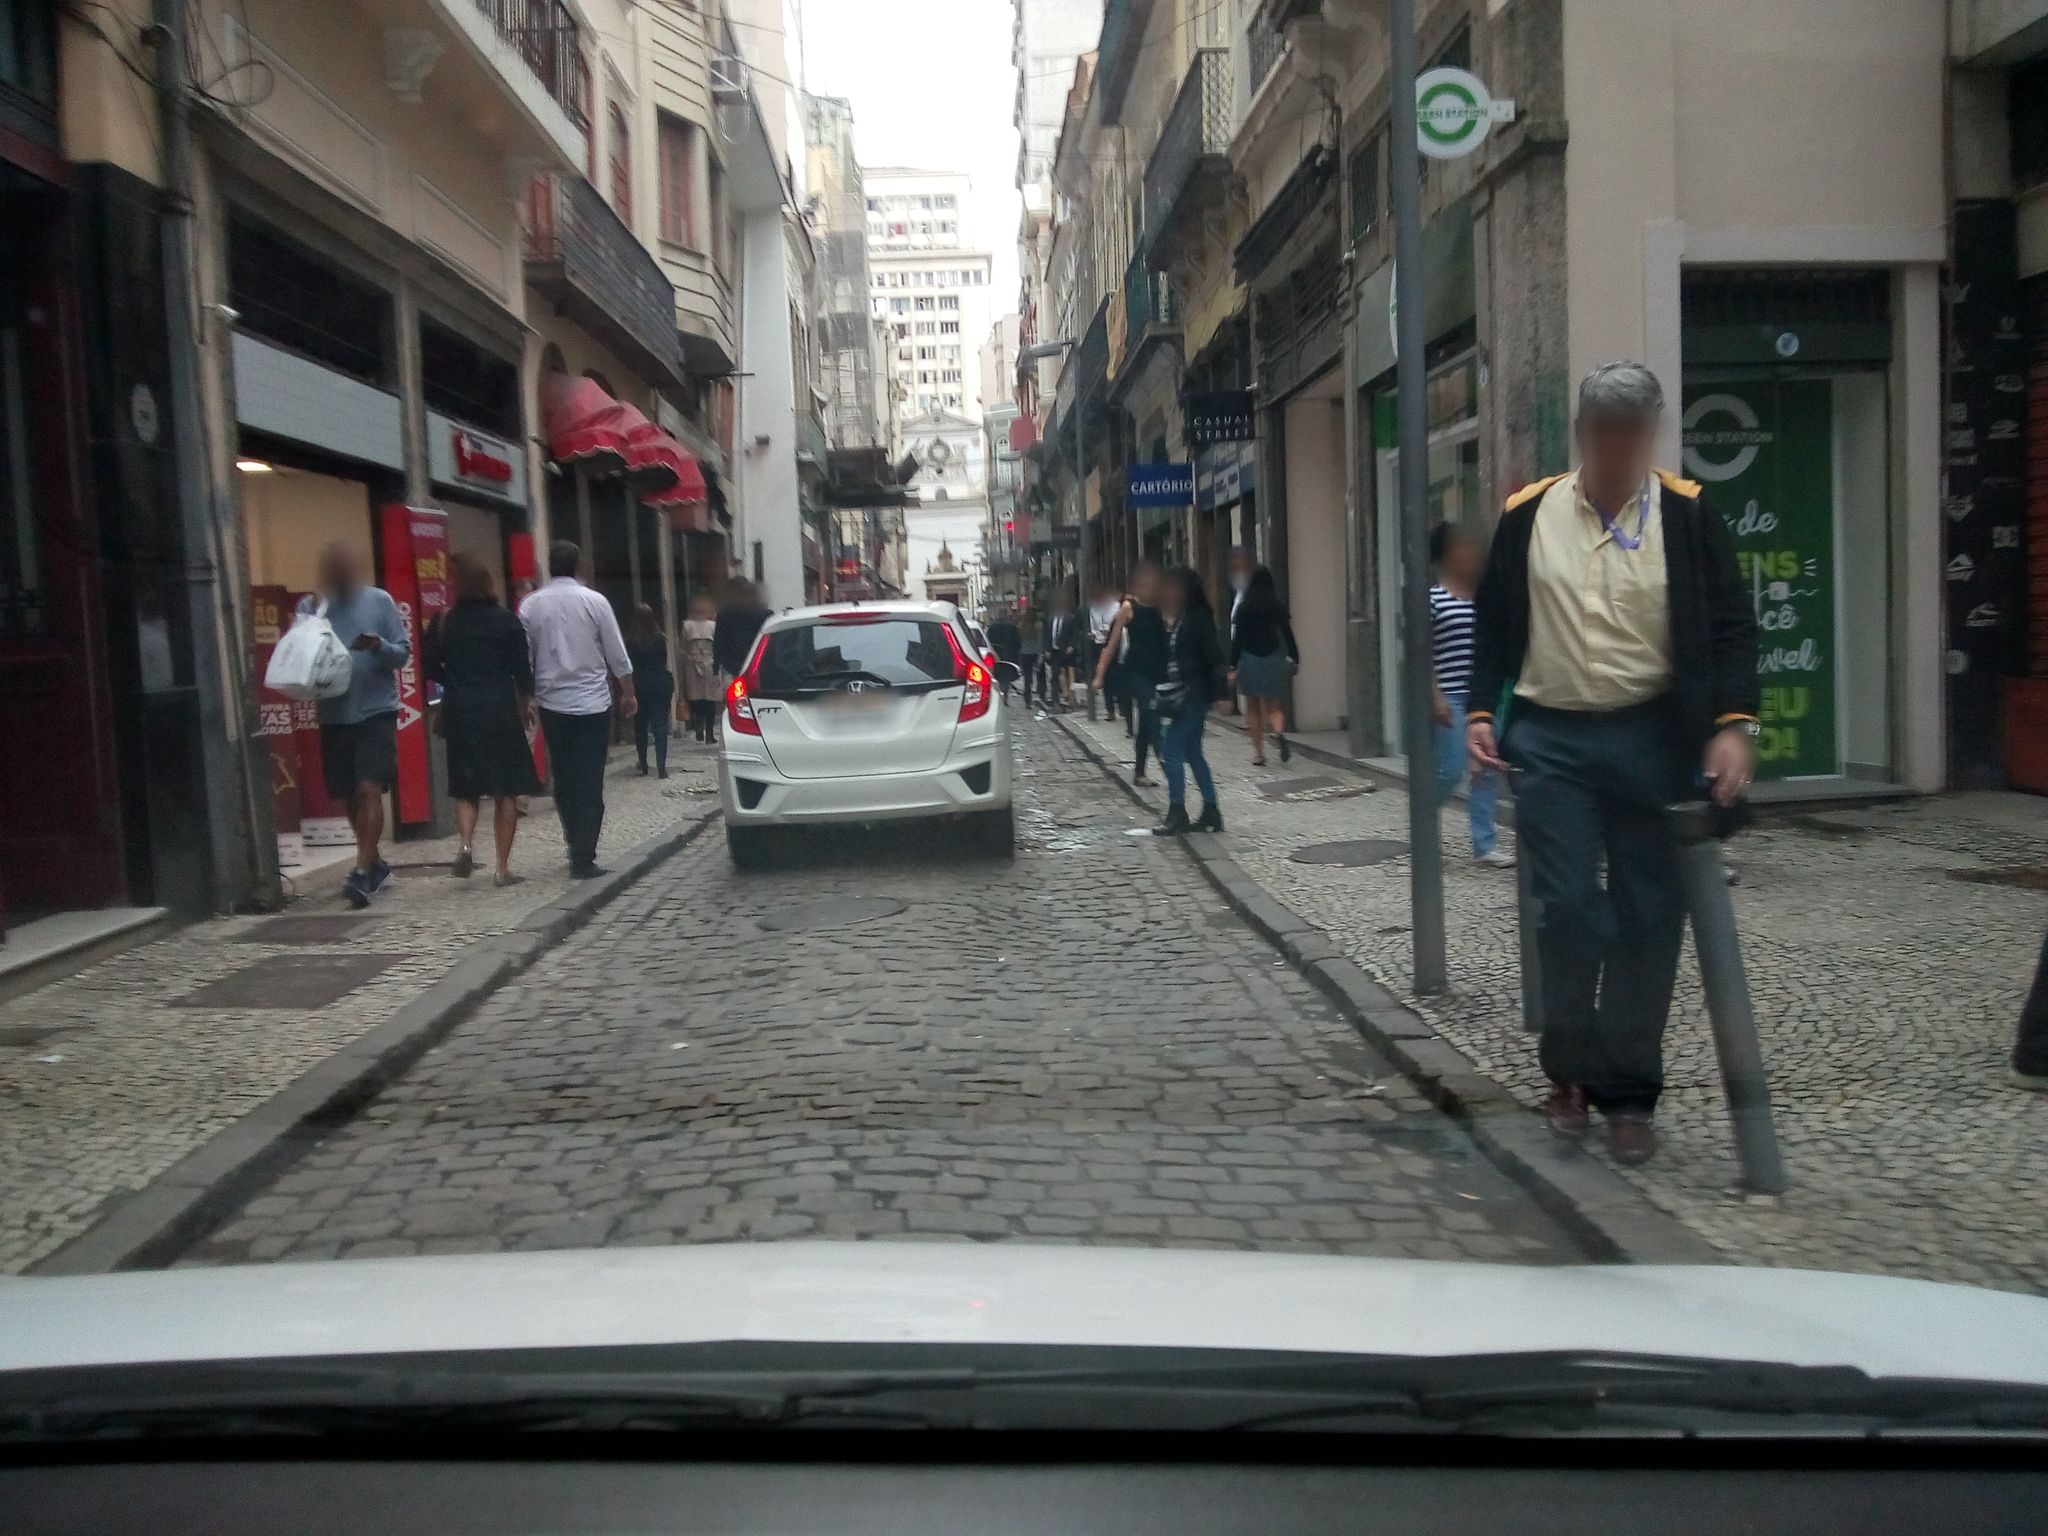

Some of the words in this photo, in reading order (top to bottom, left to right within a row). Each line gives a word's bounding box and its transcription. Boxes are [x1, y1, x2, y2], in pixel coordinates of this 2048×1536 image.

[1193, 415, 1248, 427] CASUAL
[1196, 428, 1249, 440] STREET
[1131, 478, 1193, 496] CARTÓRIO
[1736, 549, 1799, 579] ENS
[1757, 603, 1797, 630] cê
[1759, 686, 1809, 720] EU
[260, 711, 291, 725] TAS
